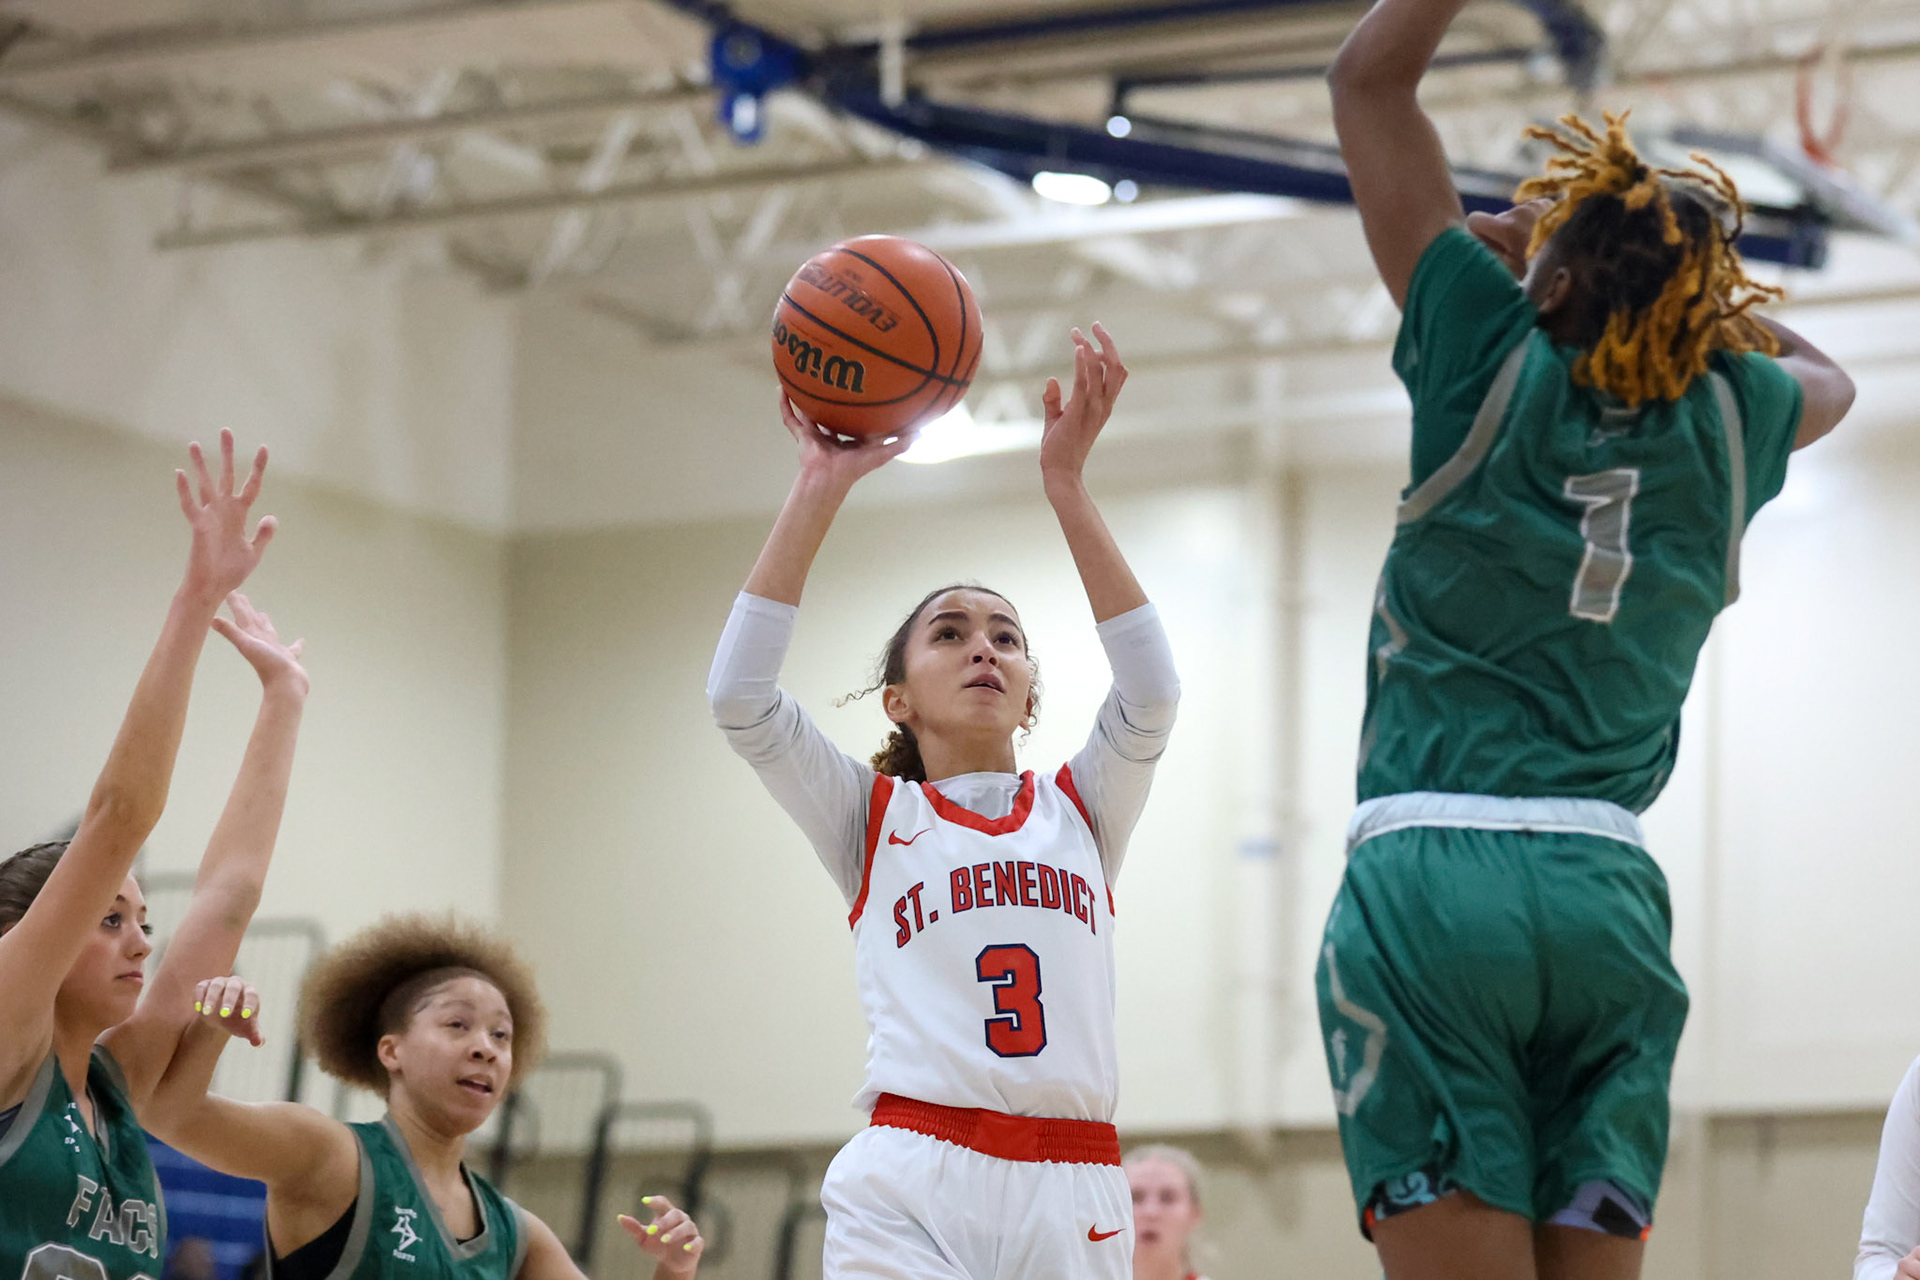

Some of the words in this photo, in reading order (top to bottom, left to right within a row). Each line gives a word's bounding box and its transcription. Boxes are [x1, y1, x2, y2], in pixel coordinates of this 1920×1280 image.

[892, 881, 939, 949] ST.
[949, 860, 1097, 936] BENEDICT
[975, 942, 1048, 1058] 3
